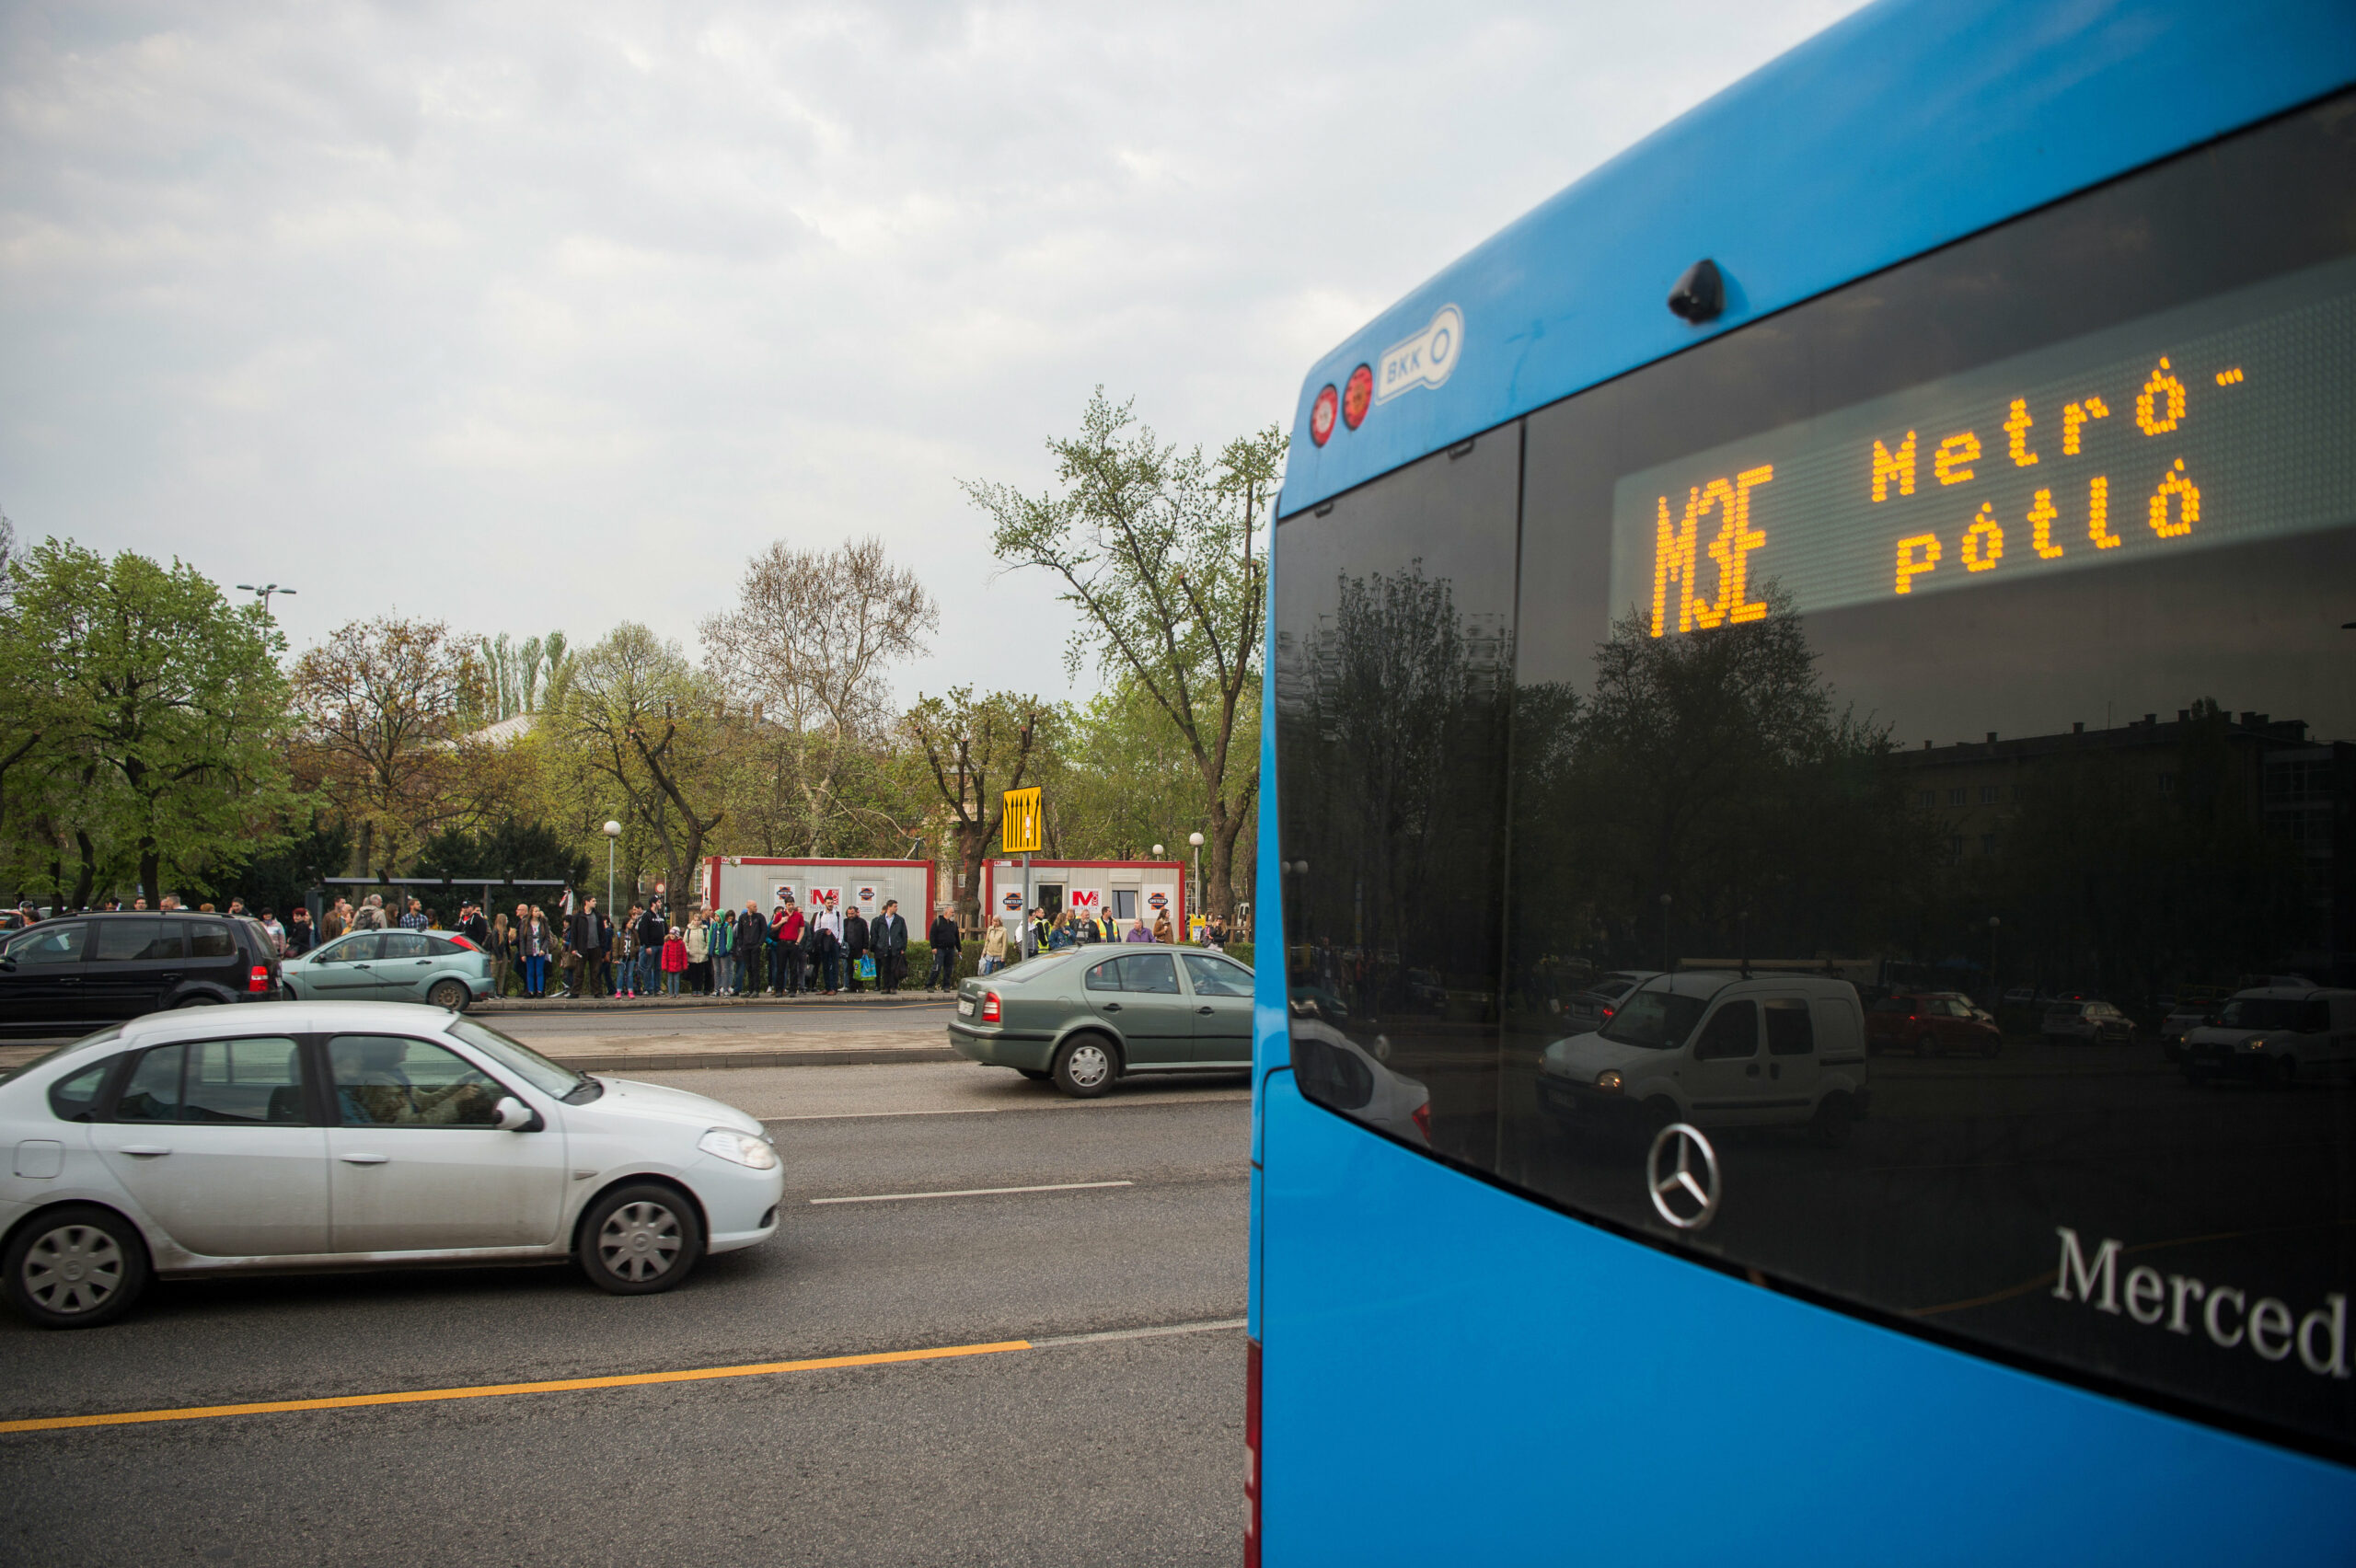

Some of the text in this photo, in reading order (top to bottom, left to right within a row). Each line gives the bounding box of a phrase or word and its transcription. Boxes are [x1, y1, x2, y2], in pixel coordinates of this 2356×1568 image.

[1387, 346, 1422, 384] BKK
[1650, 356, 2244, 638] M3E Metró-
[2051, 1225, 2356, 1378] Merced
